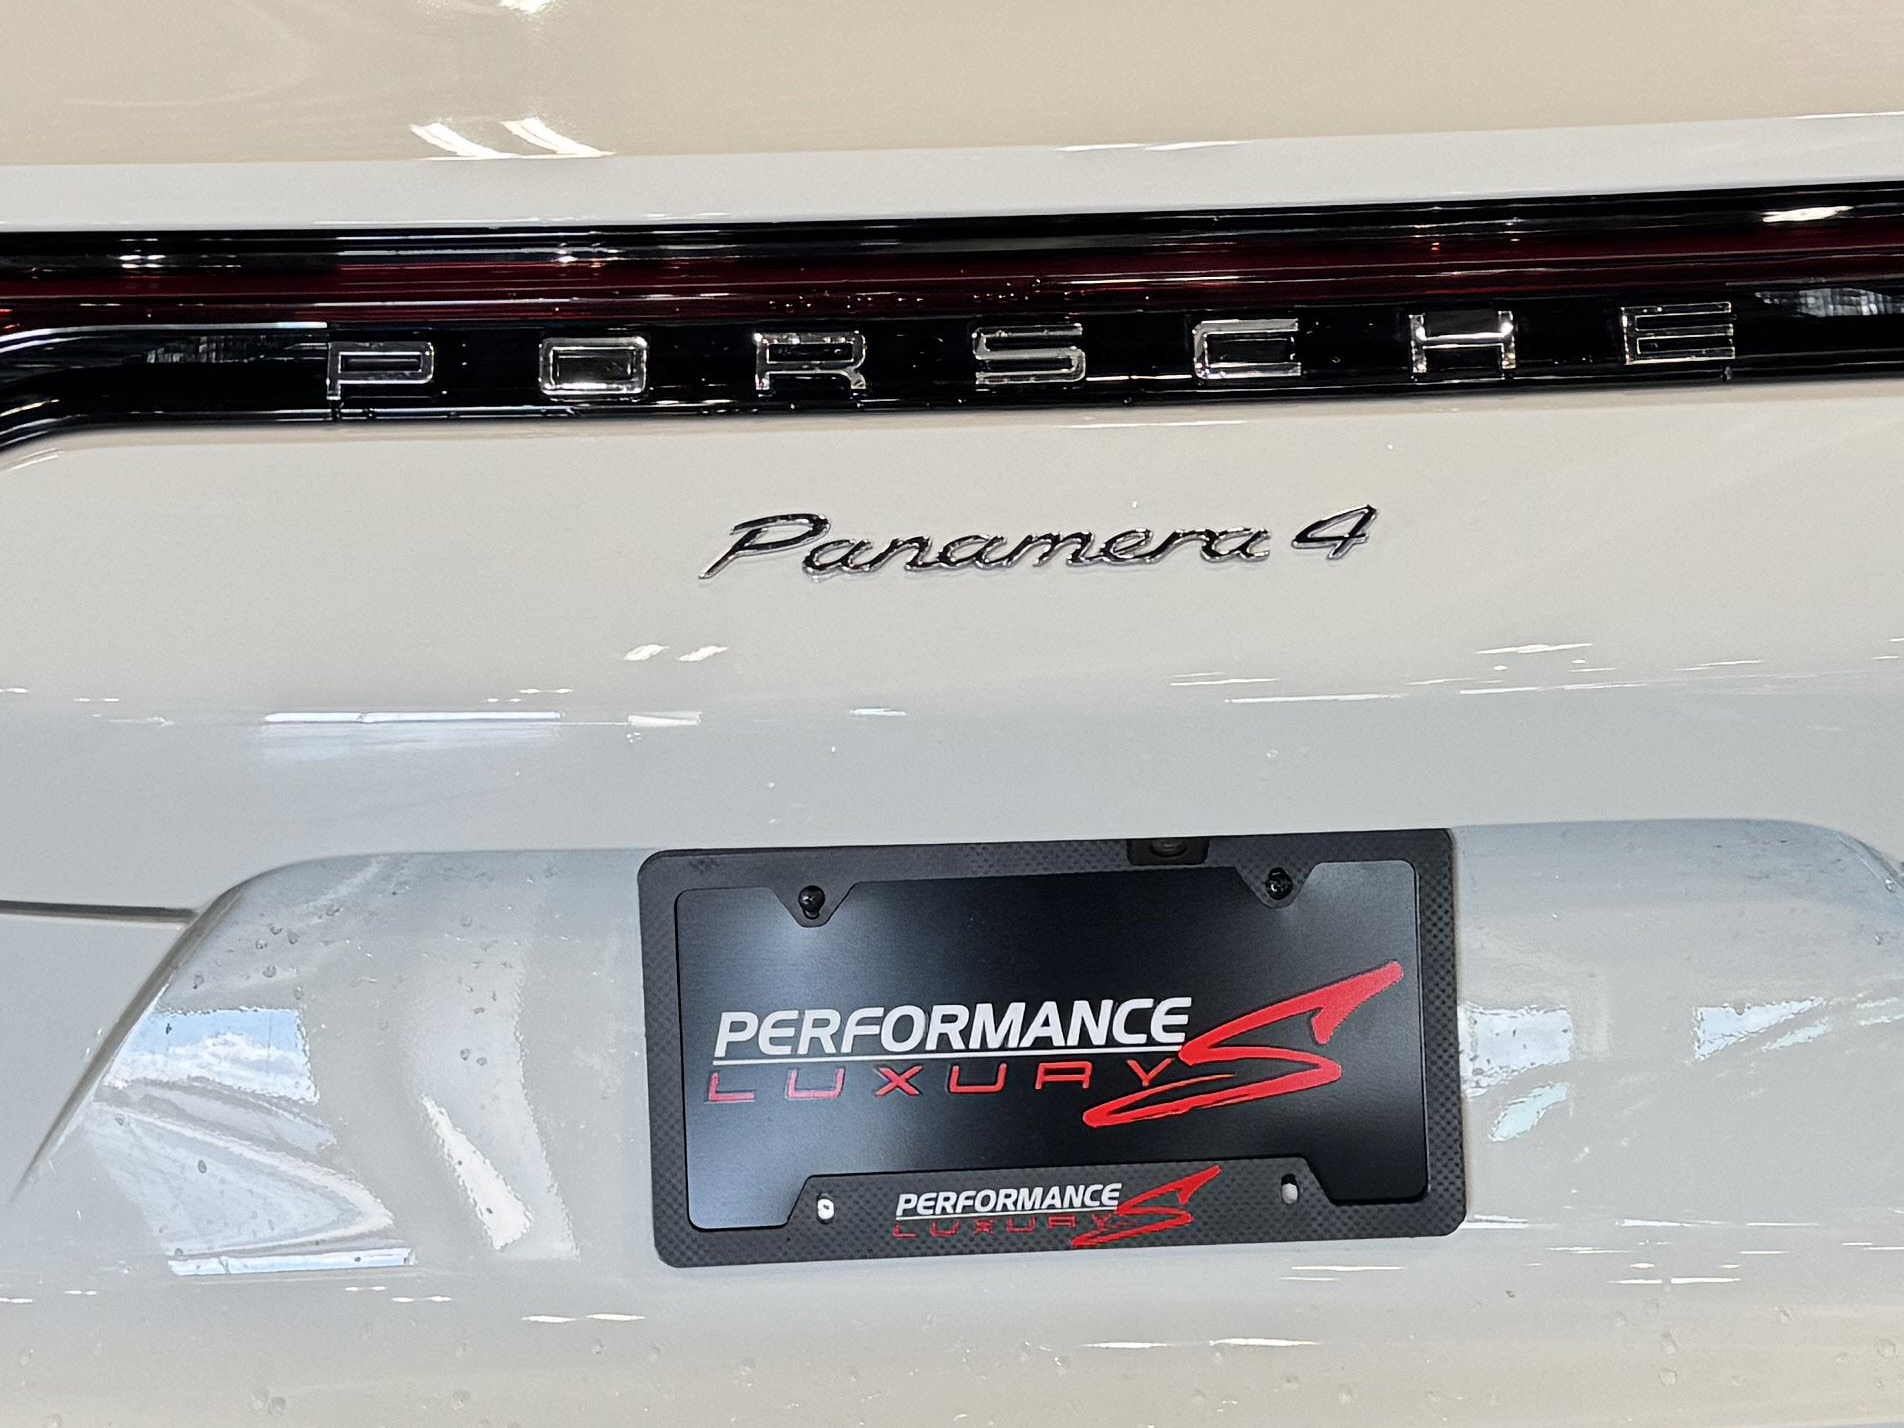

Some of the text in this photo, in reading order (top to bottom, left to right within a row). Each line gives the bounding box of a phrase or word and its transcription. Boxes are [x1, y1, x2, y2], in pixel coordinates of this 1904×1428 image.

[325, 301, 1735, 402] PORSCHE
[697, 503, 1378, 580] Panamera 4
[713, 996, 1193, 1058] PERFORMANCE
[706, 1057, 1175, 1104] LUXURY
[892, 1212, 1114, 1240] LUXURY
[895, 1183, 1123, 1217] PERFORMANCE
